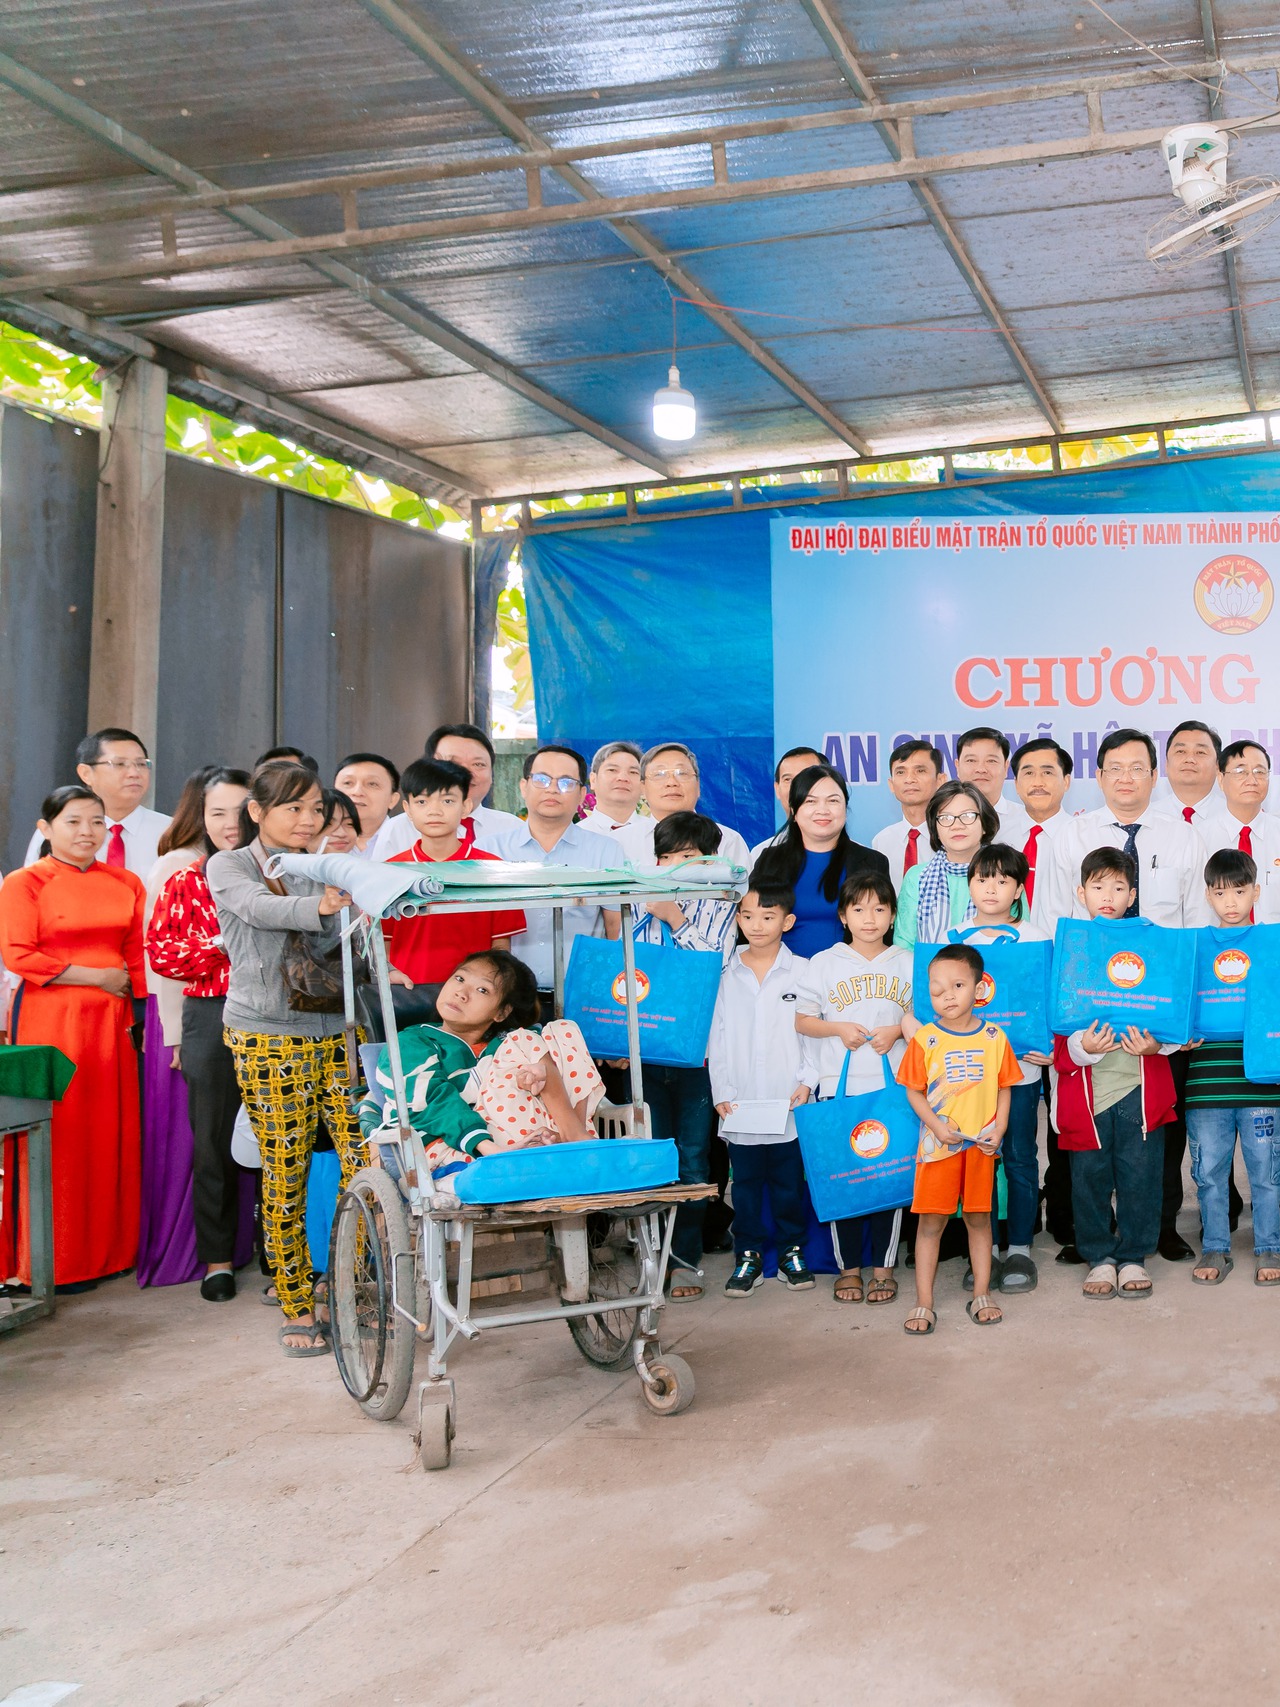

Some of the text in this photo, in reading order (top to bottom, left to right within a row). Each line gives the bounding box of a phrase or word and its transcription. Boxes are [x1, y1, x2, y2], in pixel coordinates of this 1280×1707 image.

[791, 528, 820, 554] ĐẠI
[825, 523, 853, 554] HỘI
[858, 527, 887, 553] ĐẠI
[892, 518, 930, 548] BIỂU
[936, 522, 972, 552] MẶT
[977, 521, 1021, 551] TRẬN
[1026, 517, 1047, 546] TỔ
[1052, 517, 1097, 548] QUỐC
[1102, 520, 1138, 550] VIỆT
[1142, 523, 1182, 545] NAM
[1186, 518, 1242, 545] THÀNH
[1247, 514, 1280, 543] PHỐ
[955, 646, 1261, 709] CHƯƠNG
[823, 735, 878, 783] AN
[944, 1049, 984, 1083] 65
